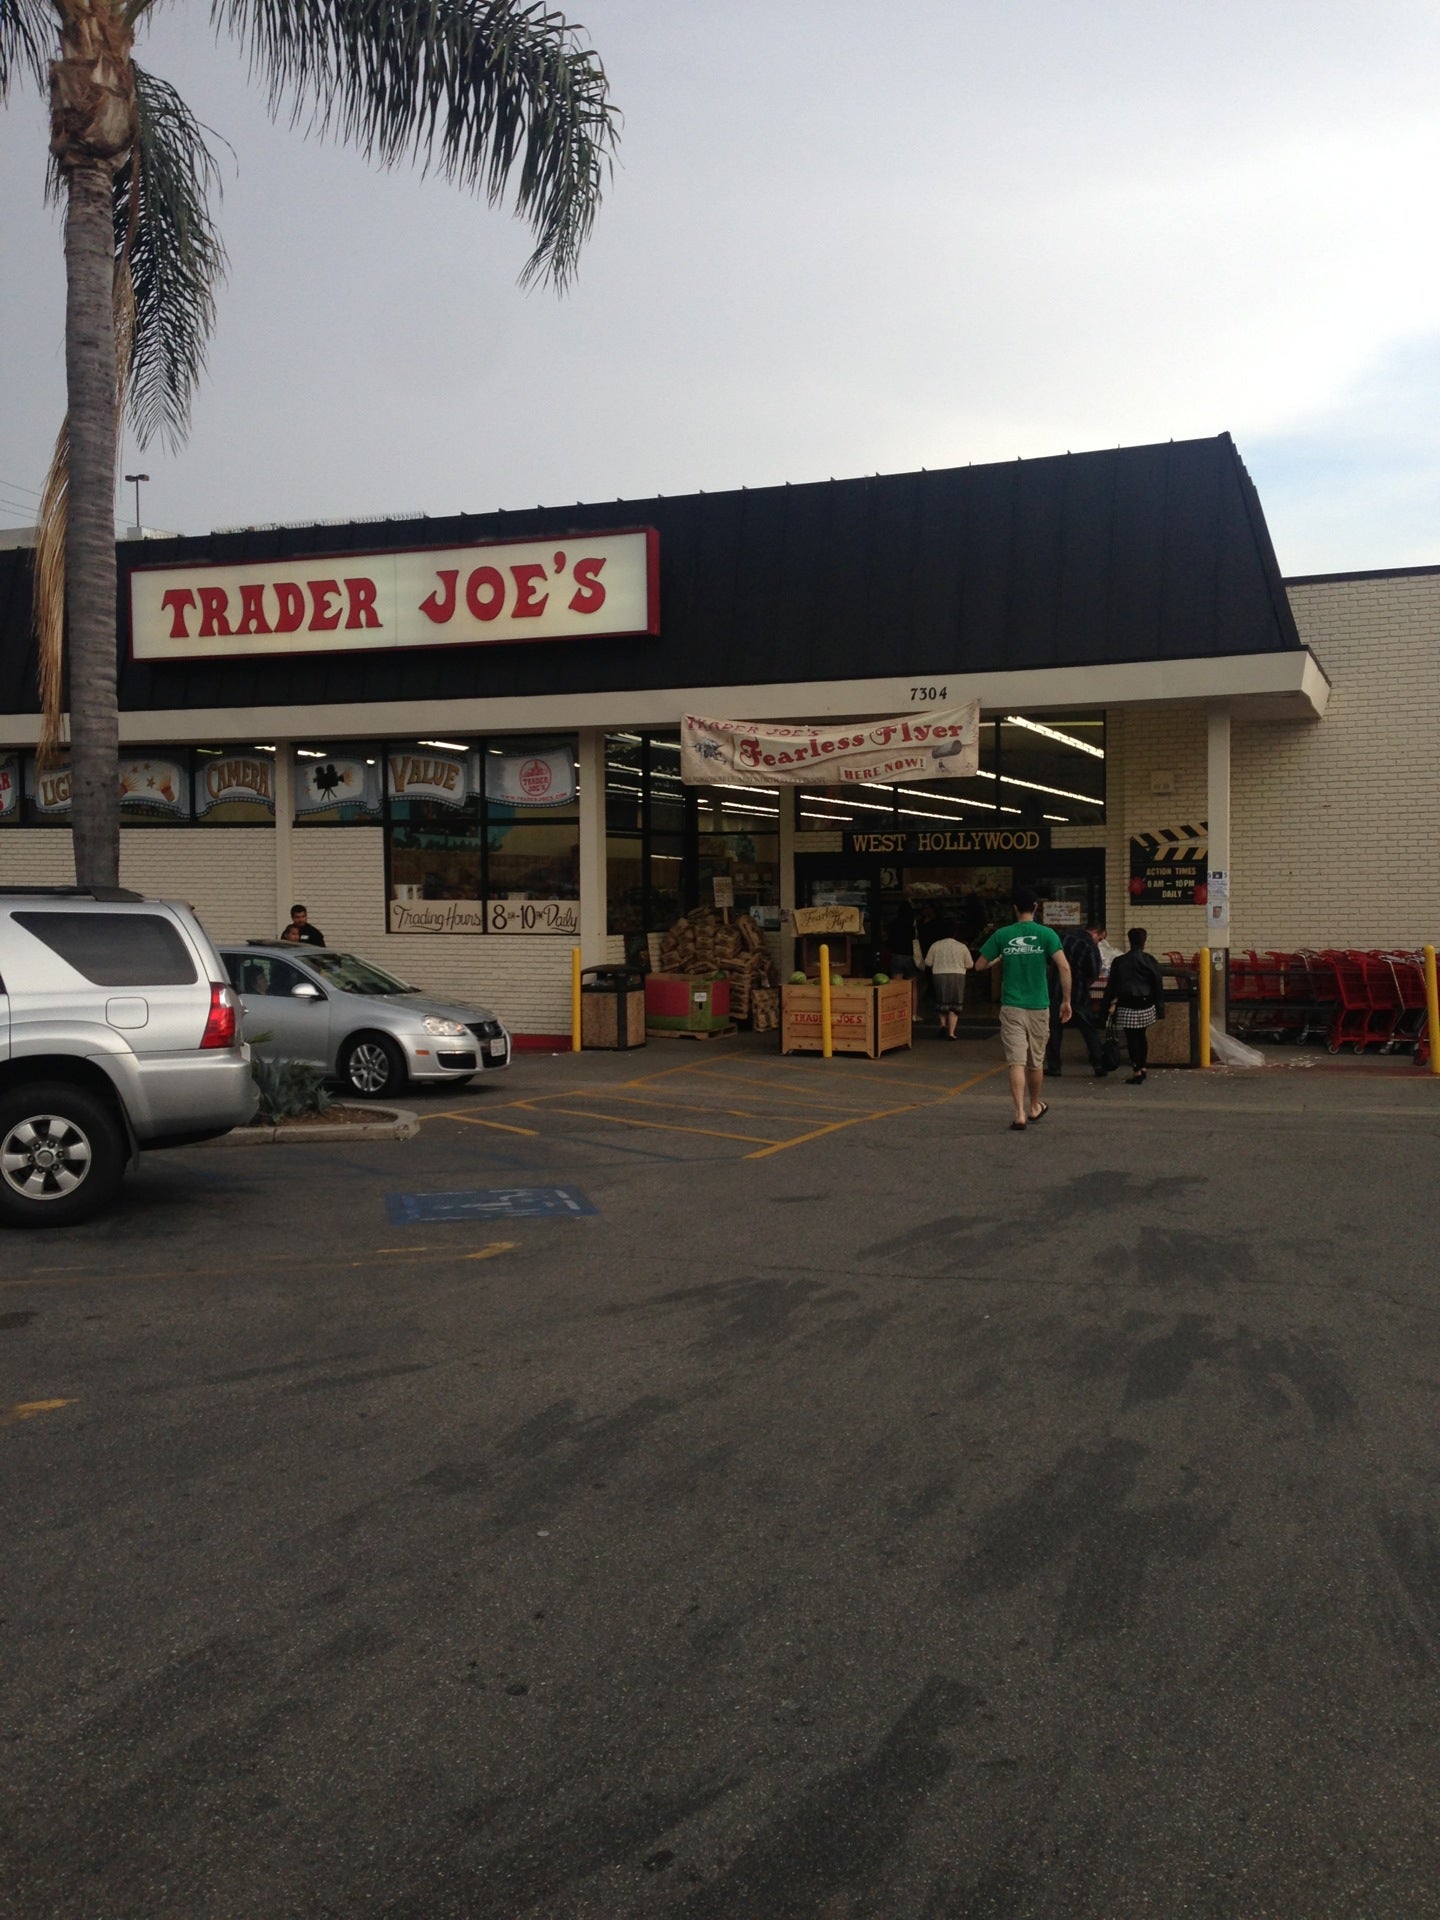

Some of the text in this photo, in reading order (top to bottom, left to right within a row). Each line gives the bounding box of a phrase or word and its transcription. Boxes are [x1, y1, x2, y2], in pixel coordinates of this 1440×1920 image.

[161, 550, 606, 639] TRADER JOE'S
[909, 686, 948, 701] 7304
[686, 715, 822, 738] TRADER JOE'S
[739, 722, 964, 768] Fearless Flyer
[206, 760, 270, 799] CAMERA
[389, 756, 460, 793] VALUE
[844, 762, 882, 780] HERE
[884, 757, 925, 772] NOW!
[523, 776, 549, 786] TRADER
[852, 831, 1041, 852] WEST HOLLYWOOD
[1146, 867, 1197, 876] ACTION TIMES
[1161, 890, 1182, 898] DAILY
[393, 903, 481, 932] Trading Hours
[543, 904, 577, 933] Daily
